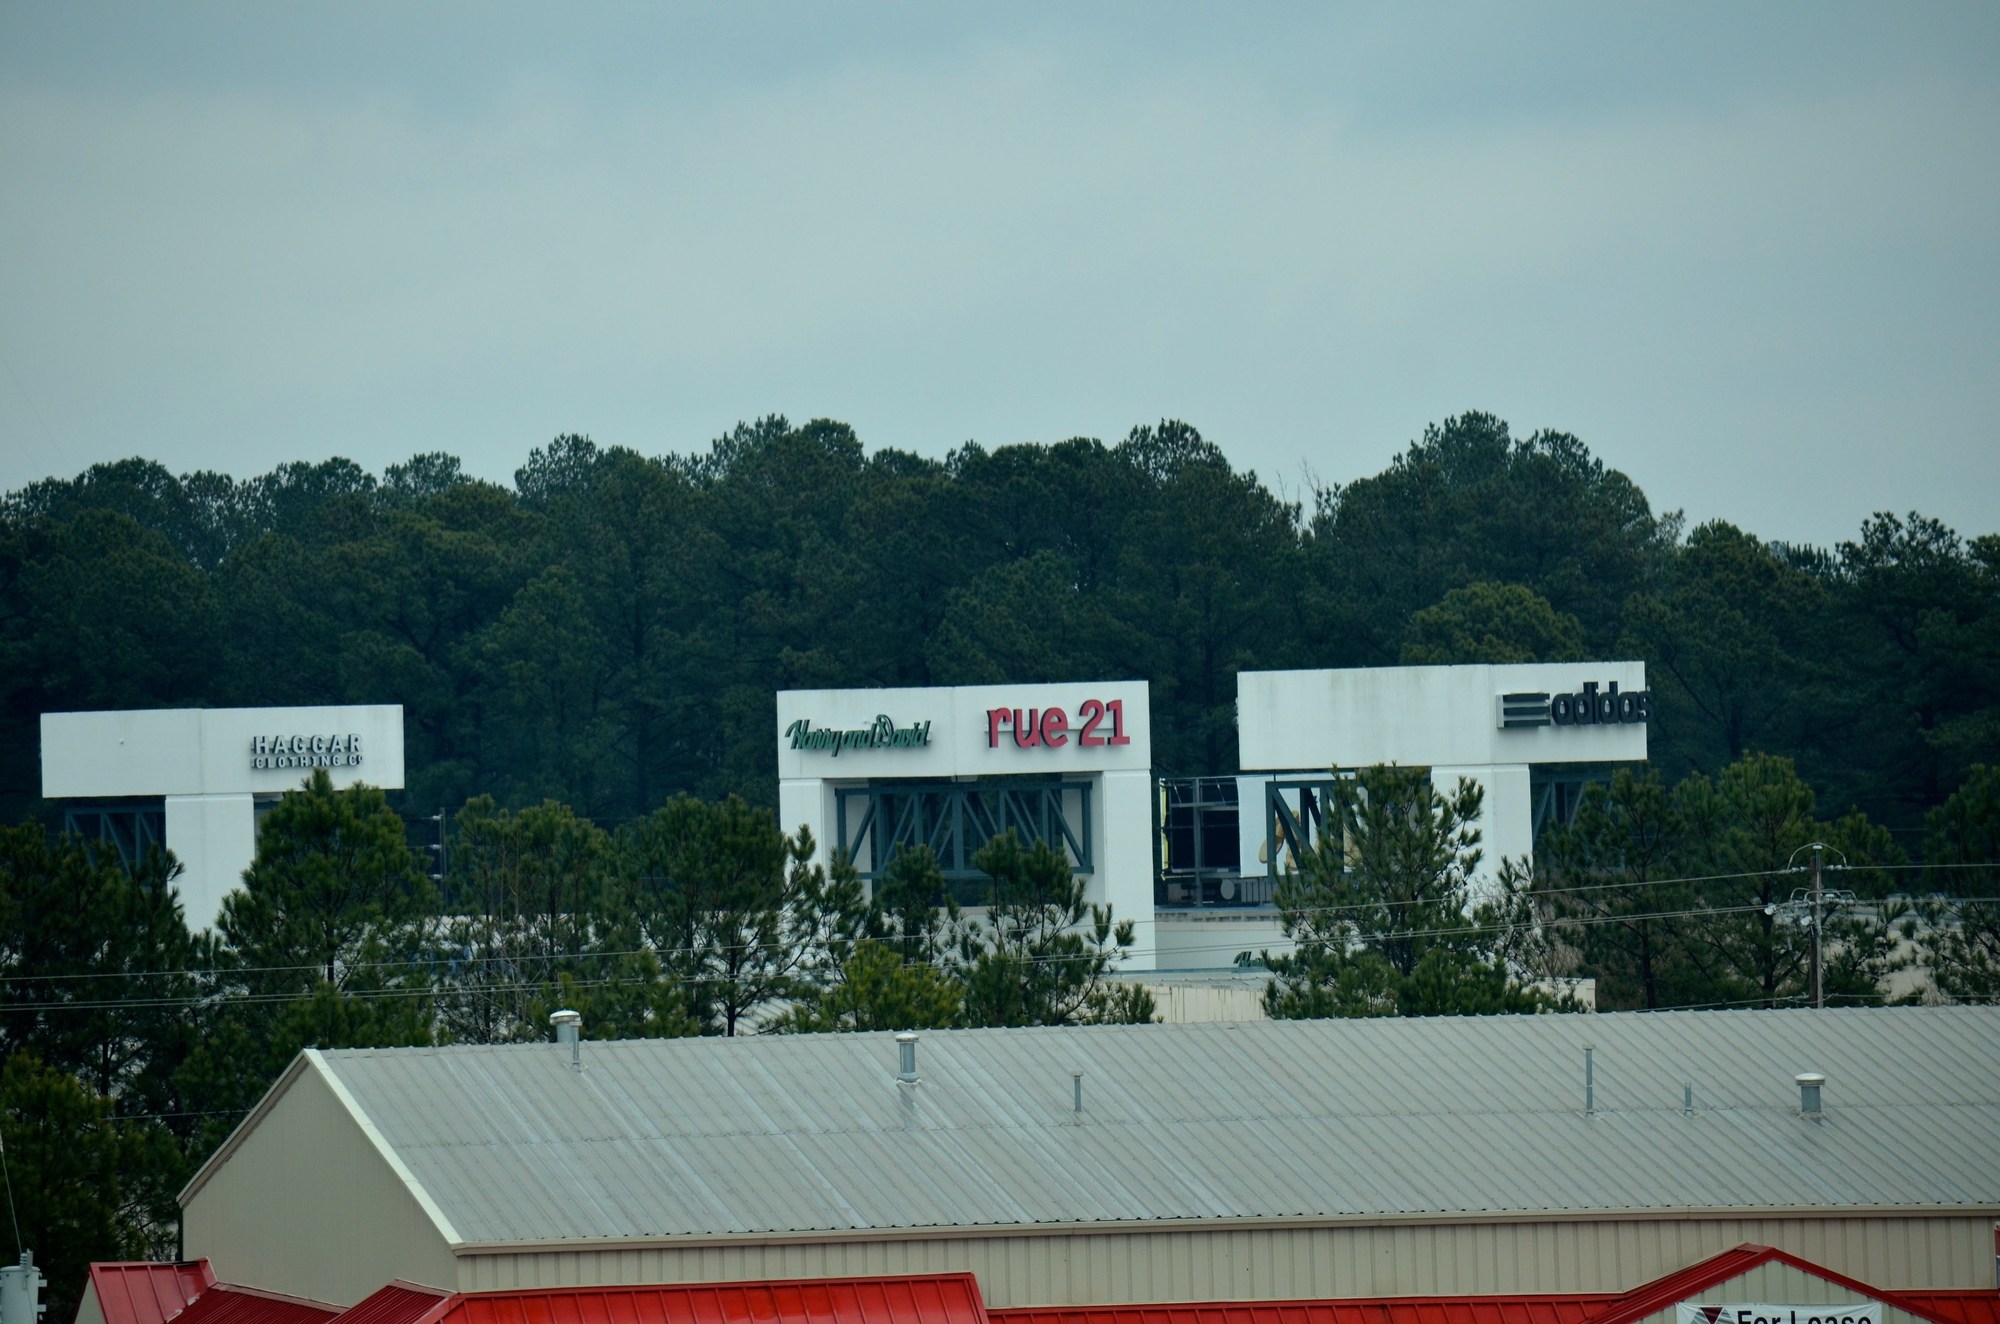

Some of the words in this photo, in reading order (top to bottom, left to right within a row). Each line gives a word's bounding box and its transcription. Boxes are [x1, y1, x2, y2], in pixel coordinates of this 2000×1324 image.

[986, 706, 1069, 748] rue
[1078, 698, 1131, 747] 21
[1551, 680, 1654, 726] adidas
[252, 733, 364, 754] HAGGAR
[784, 719, 843, 757] Harry
[841, 722, 878, 749] and
[875, 713, 931, 748] David
[253, 755, 342, 769] CLOTHING
